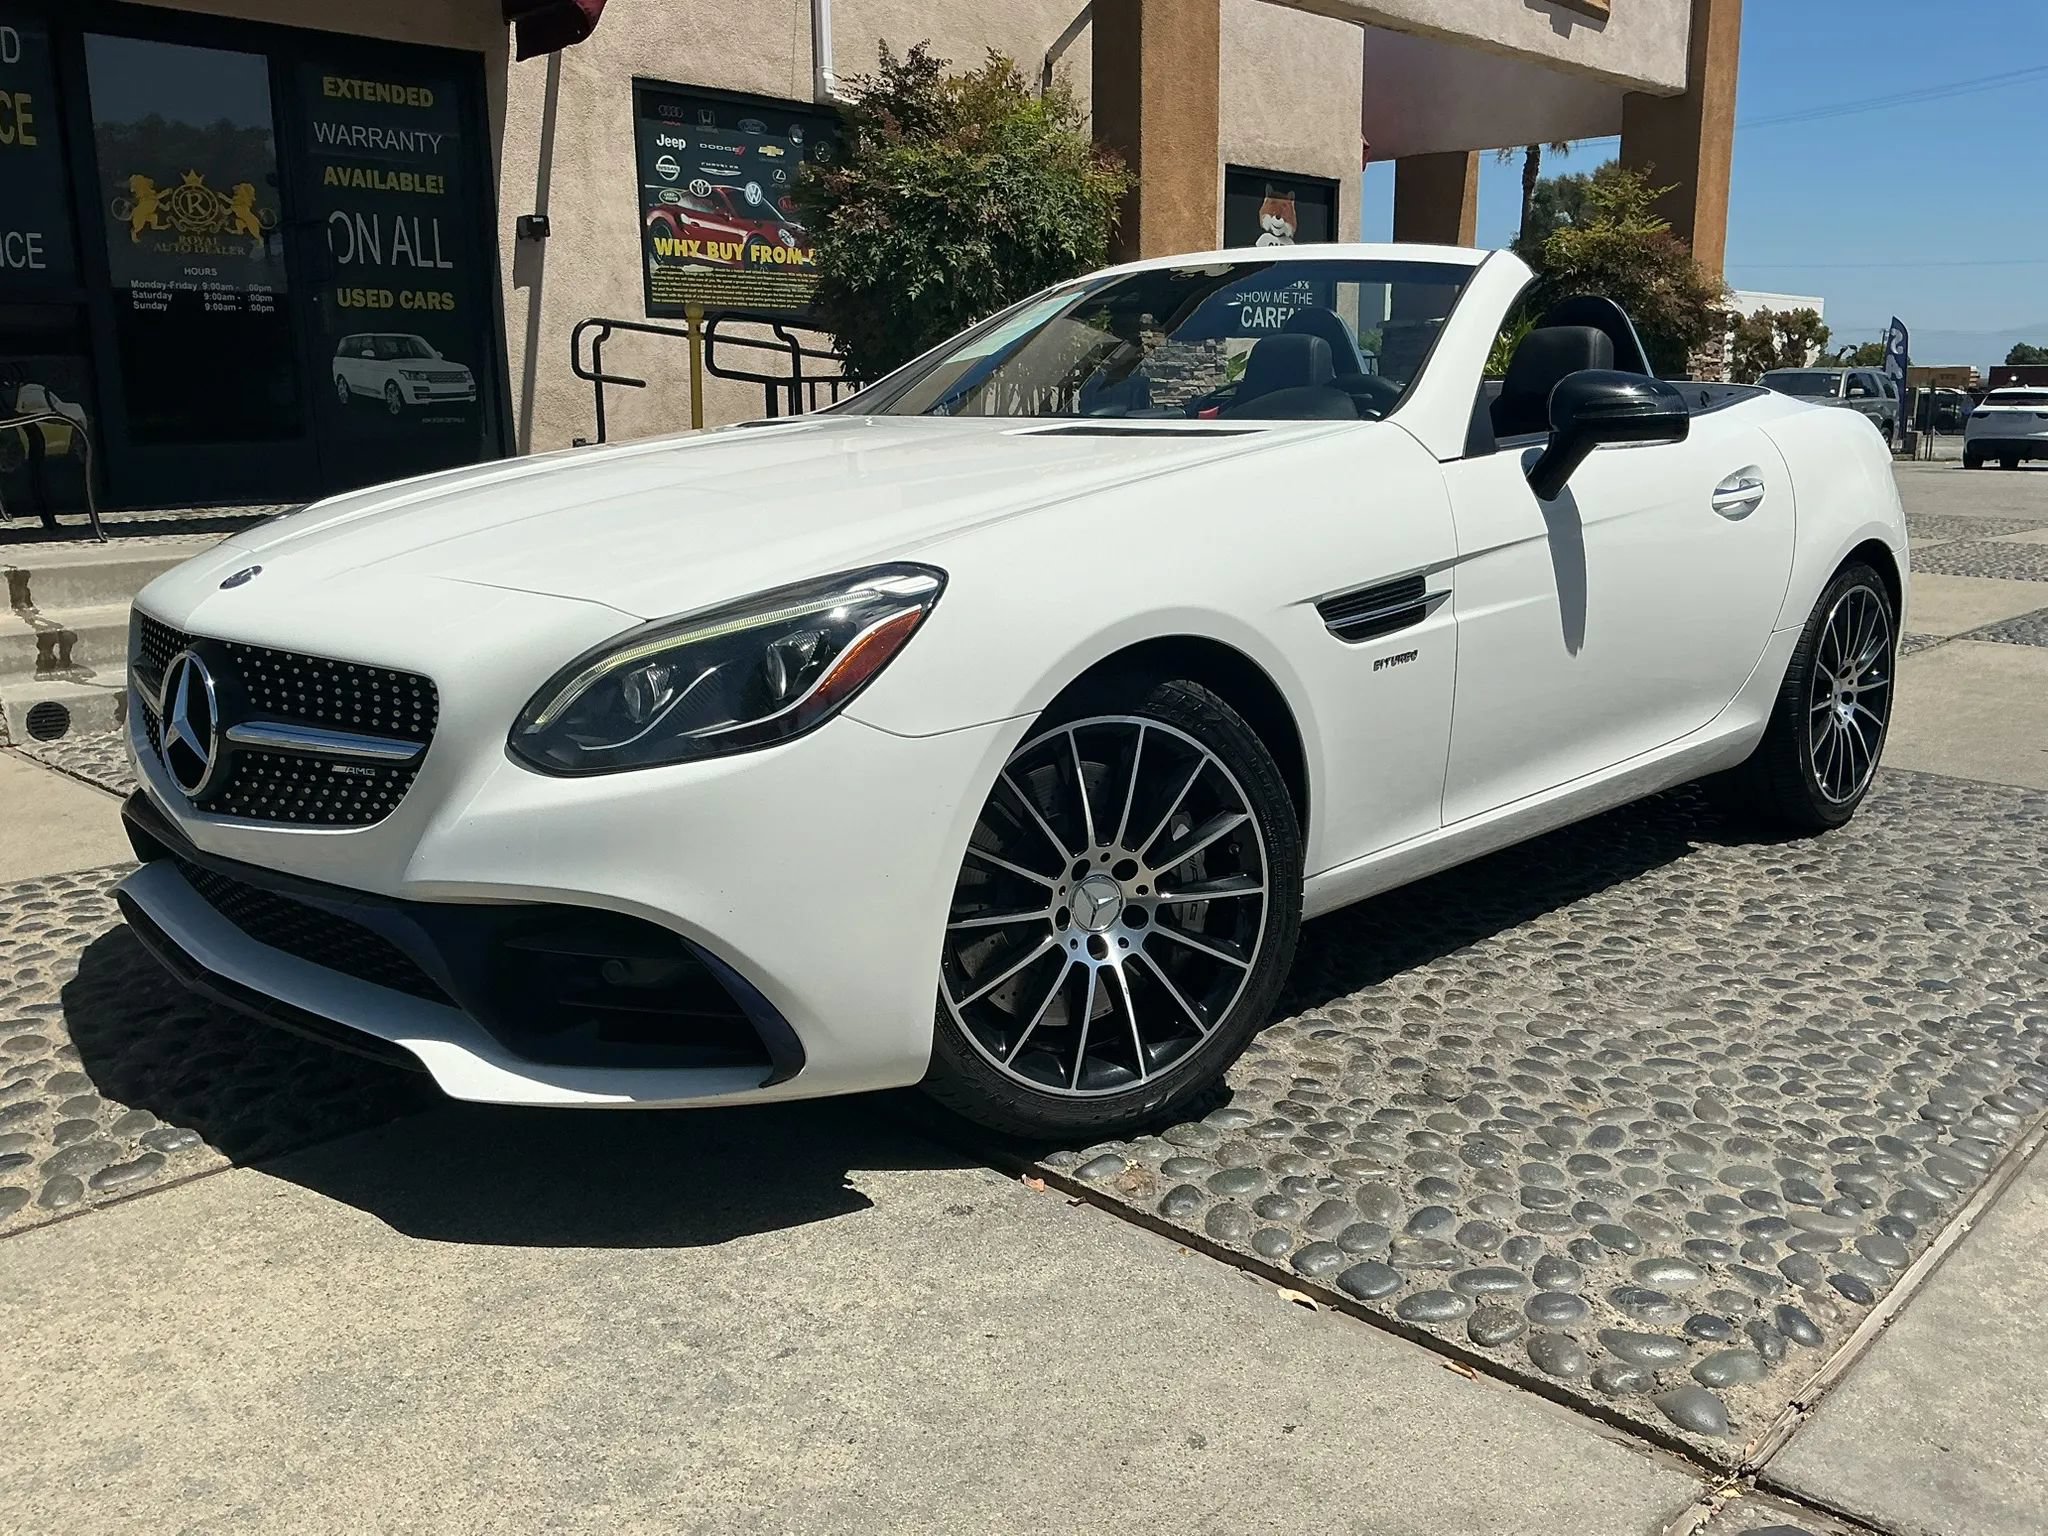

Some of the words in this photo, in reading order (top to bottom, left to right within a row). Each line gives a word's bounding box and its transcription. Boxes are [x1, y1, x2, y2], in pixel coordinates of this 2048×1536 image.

[322, 76, 434, 108] EXTENDED
[313, 121, 442, 155] WARRANTY
[656, 134, 687, 150] Jeep
[323, 166, 445, 194] AVAILABLE!
[327, 210, 382, 266] ON
[391, 216, 453, 269] ALL
[654, 237, 701, 258] WHY
[707, 241, 745, 261] BUY
[751, 245, 804, 266] FROM
[184, 267, 218, 277] HOURS
[130, 279, 198, 292] Monday-Friday
[132, 290, 173, 302] Saturday
[203, 292, 236, 301] 9:00am
[336, 287, 394, 309] USED
[399, 290, 455, 311] CARS
[1236, 291, 1271, 303] SHOW
[1273, 292, 1290, 304] ME
[1292, 292, 1313, 305] THE
[133, 301, 168, 312] Sunday
[204, 302, 237, 312] 9:00am
[1241, 306, 1301, 329] CARF
[343, 765, 376, 777] AMG
